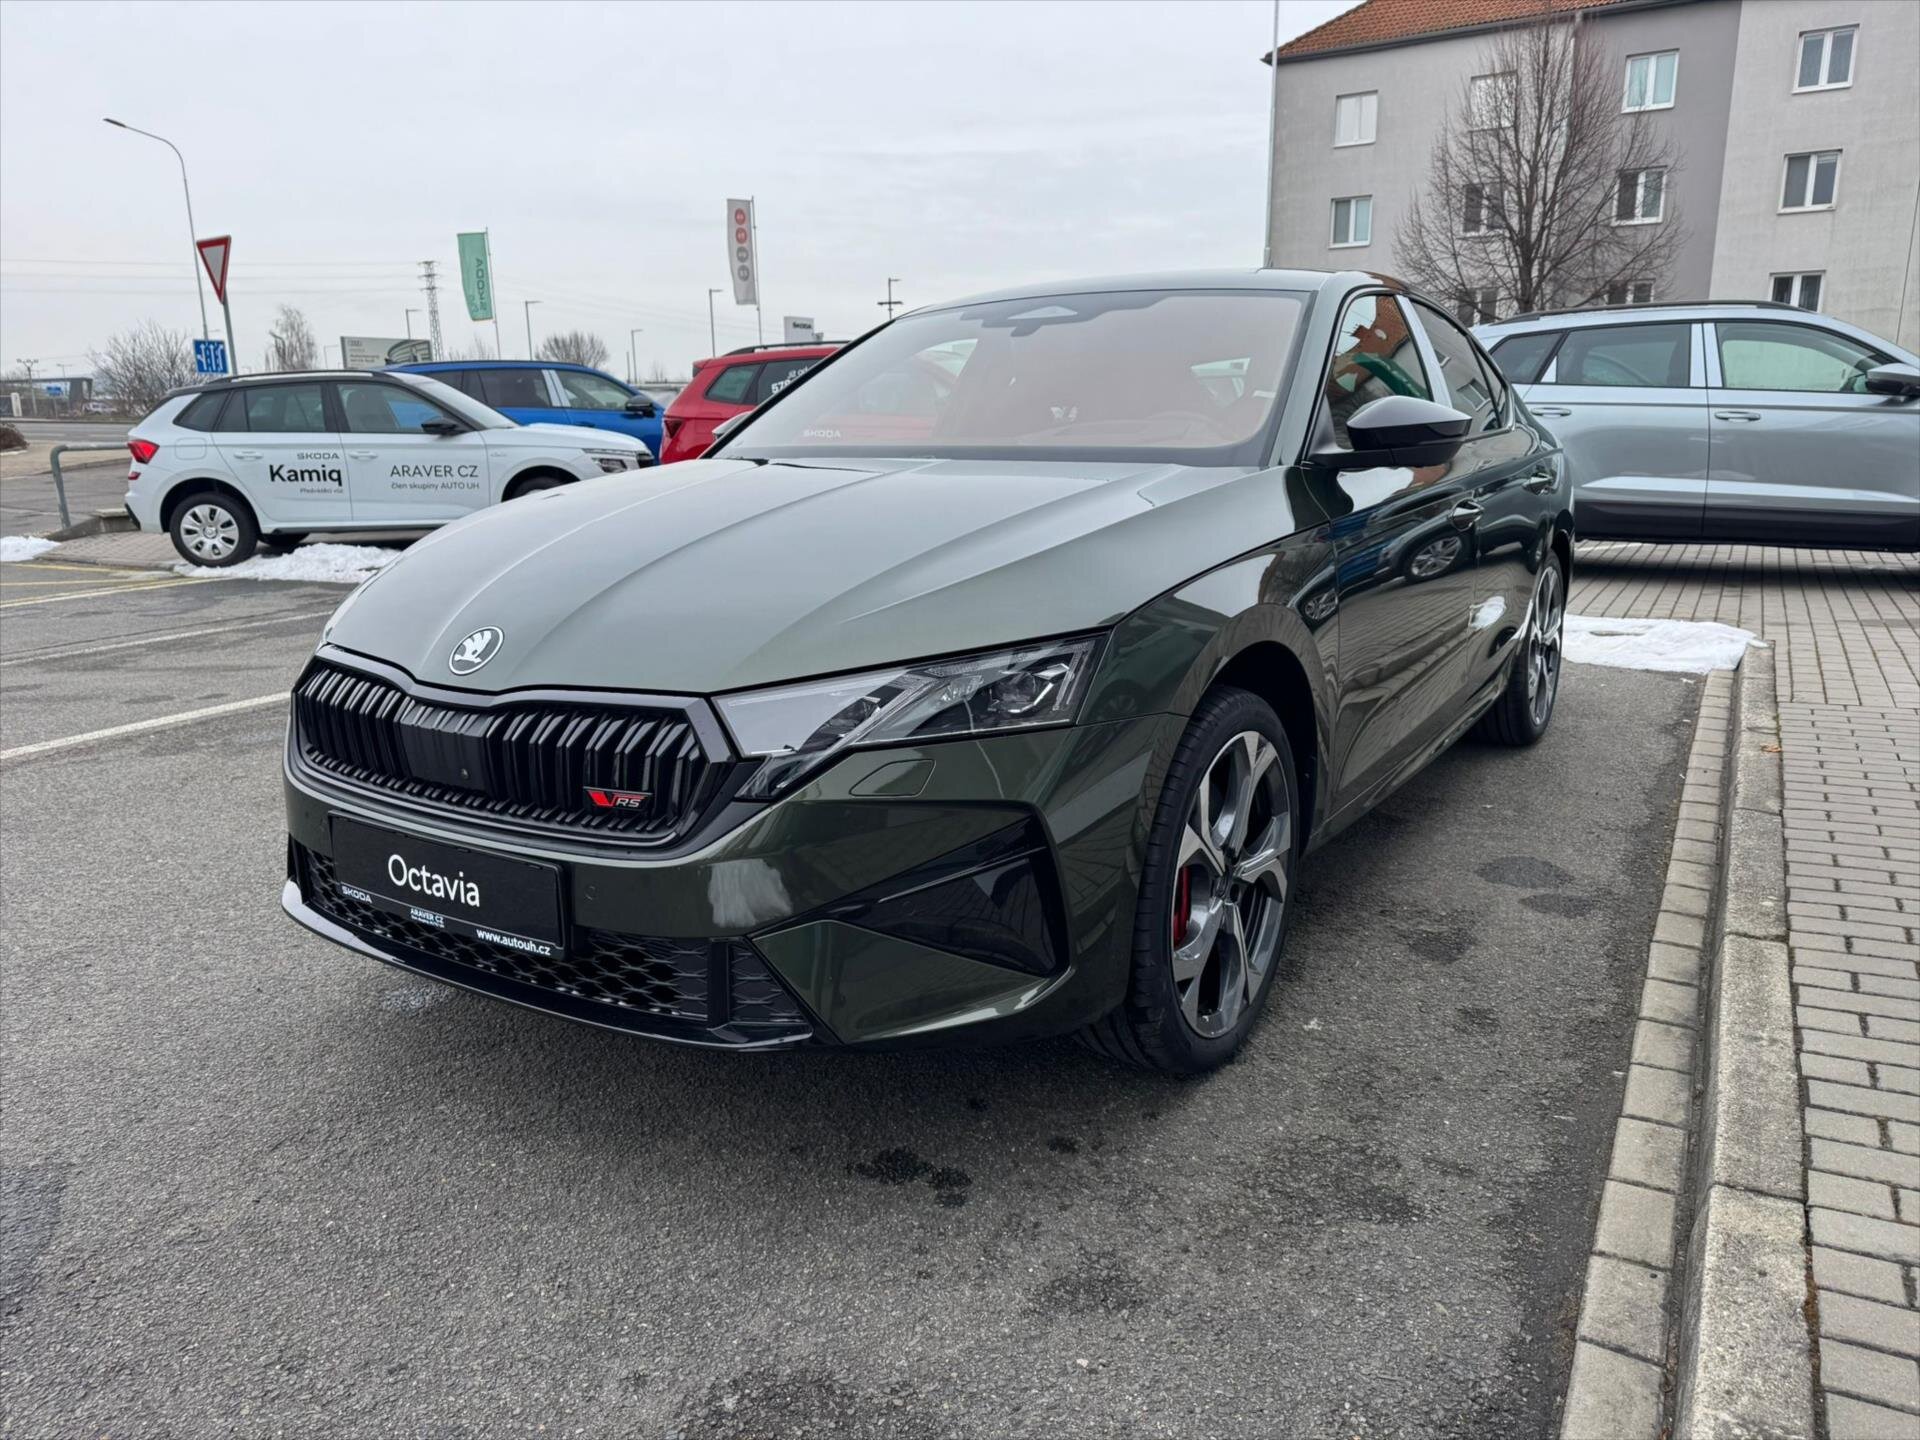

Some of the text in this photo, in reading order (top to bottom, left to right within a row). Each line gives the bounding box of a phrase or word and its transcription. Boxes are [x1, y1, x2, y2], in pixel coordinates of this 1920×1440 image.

[269, 464, 343, 487] Kamiq
[390, 465, 479, 477] ARAVER CZ
[409, 481, 439, 491] skupiny
[440, 481, 465, 490] AUTO
[466, 482, 480, 490] UH
[388, 854, 480, 907] Octavia
[476, 929, 552, 956] www.autouh.cz
